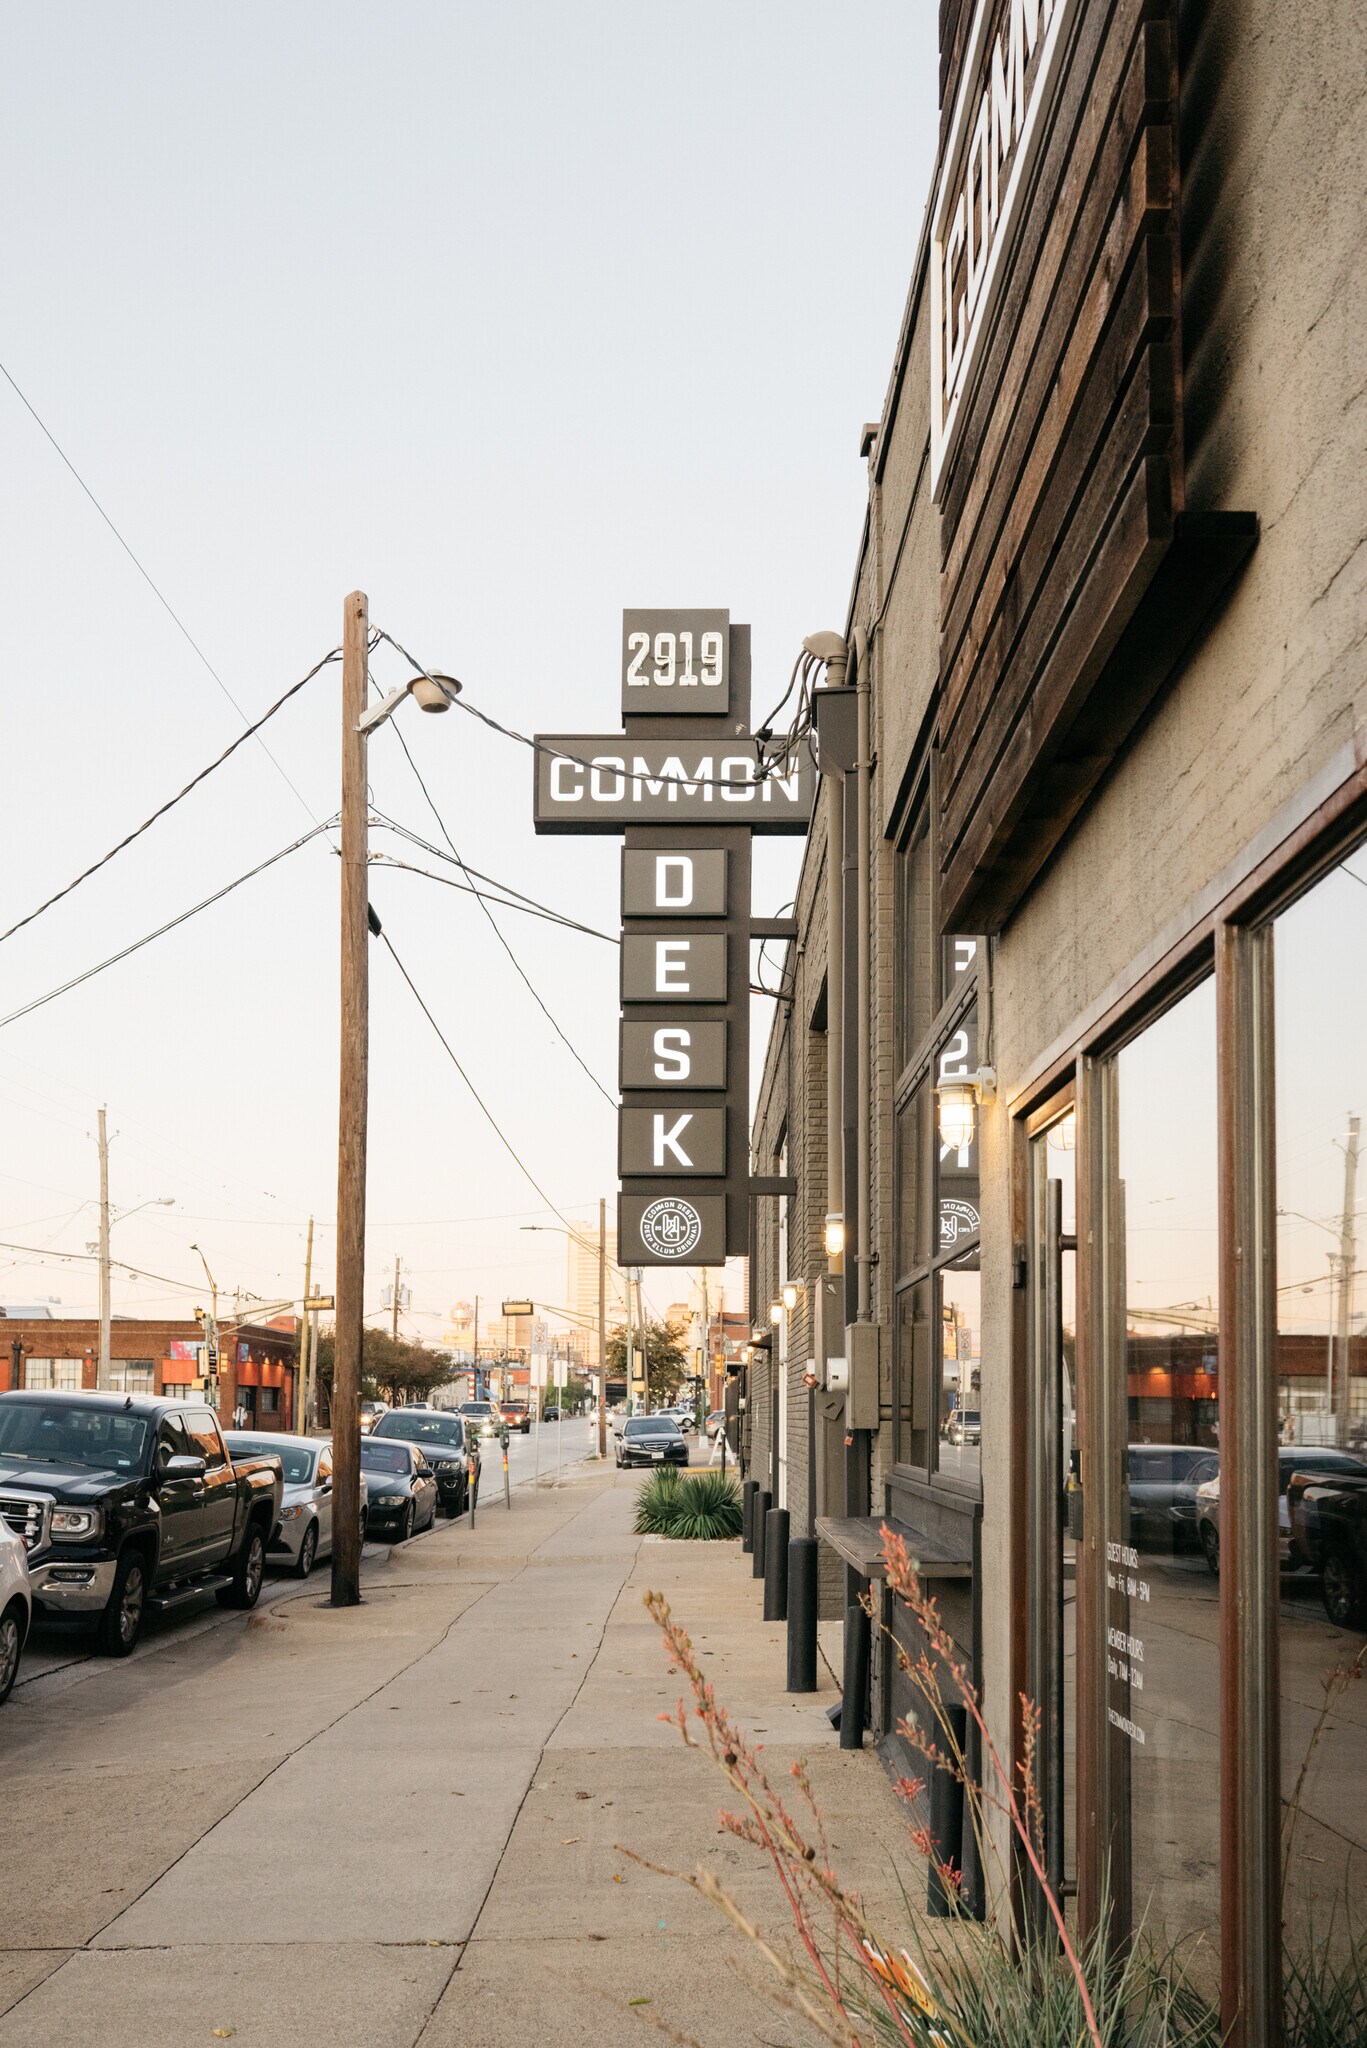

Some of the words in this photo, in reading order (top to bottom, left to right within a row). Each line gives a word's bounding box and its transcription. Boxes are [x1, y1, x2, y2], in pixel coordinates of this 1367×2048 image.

[627, 631, 723, 687] 2919
[550, 756, 799, 802] COMMON
[653, 855, 694, 1167] DESK
[647, 1201, 675, 1219] COMMON
[677, 1203, 695, 1220] DESK
[644, 1224, 654, 1242] DEEP
[652, 1242, 675, 1254] ELLUM
[676, 1225, 697, 1253] ORIGINAL
[1107, 1541, 1121, 1563] GUEST
[1107, 1626, 1127, 1653] MEMBER
